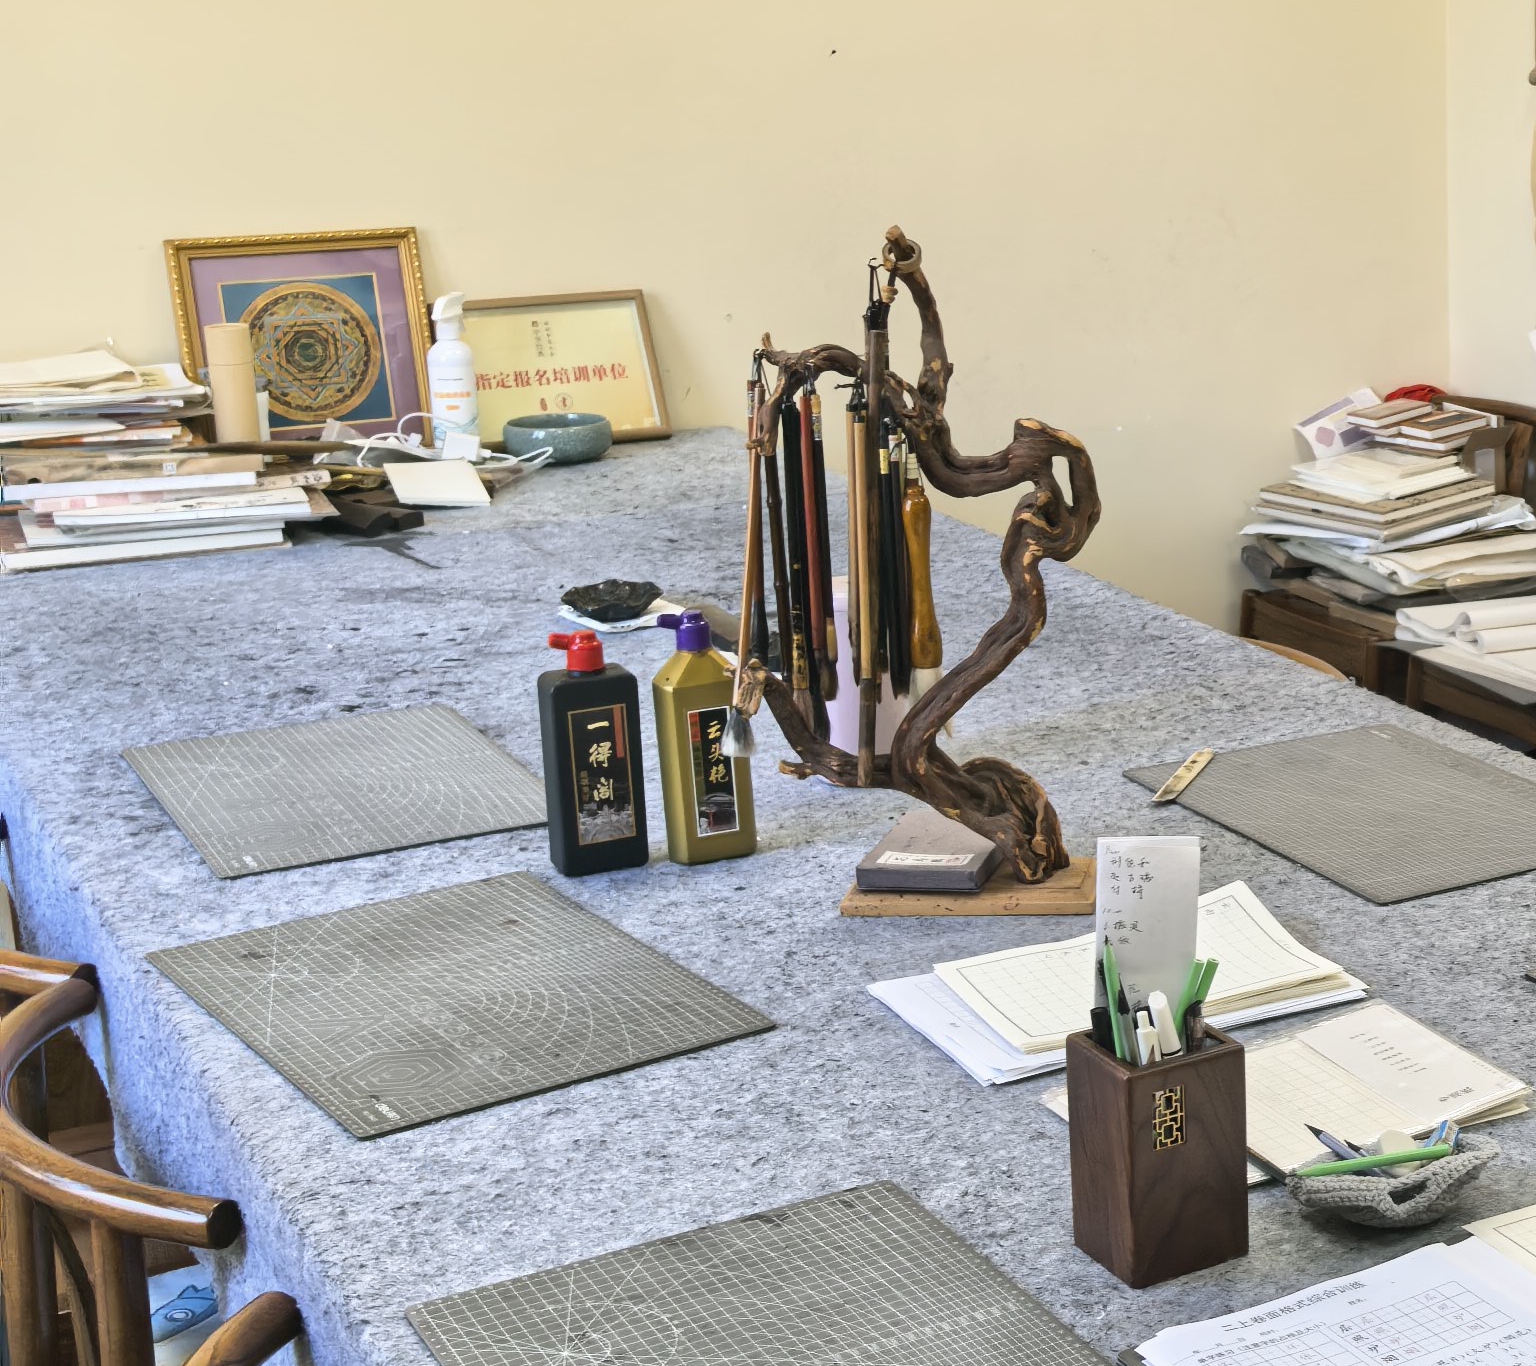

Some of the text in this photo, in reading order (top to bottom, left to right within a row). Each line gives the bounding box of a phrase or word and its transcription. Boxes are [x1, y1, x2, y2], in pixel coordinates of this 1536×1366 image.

[475, 363, 628, 392] 指定报名培训单位
[1221, 1280, 1367, 1332] 二上卷面格式综合训练
